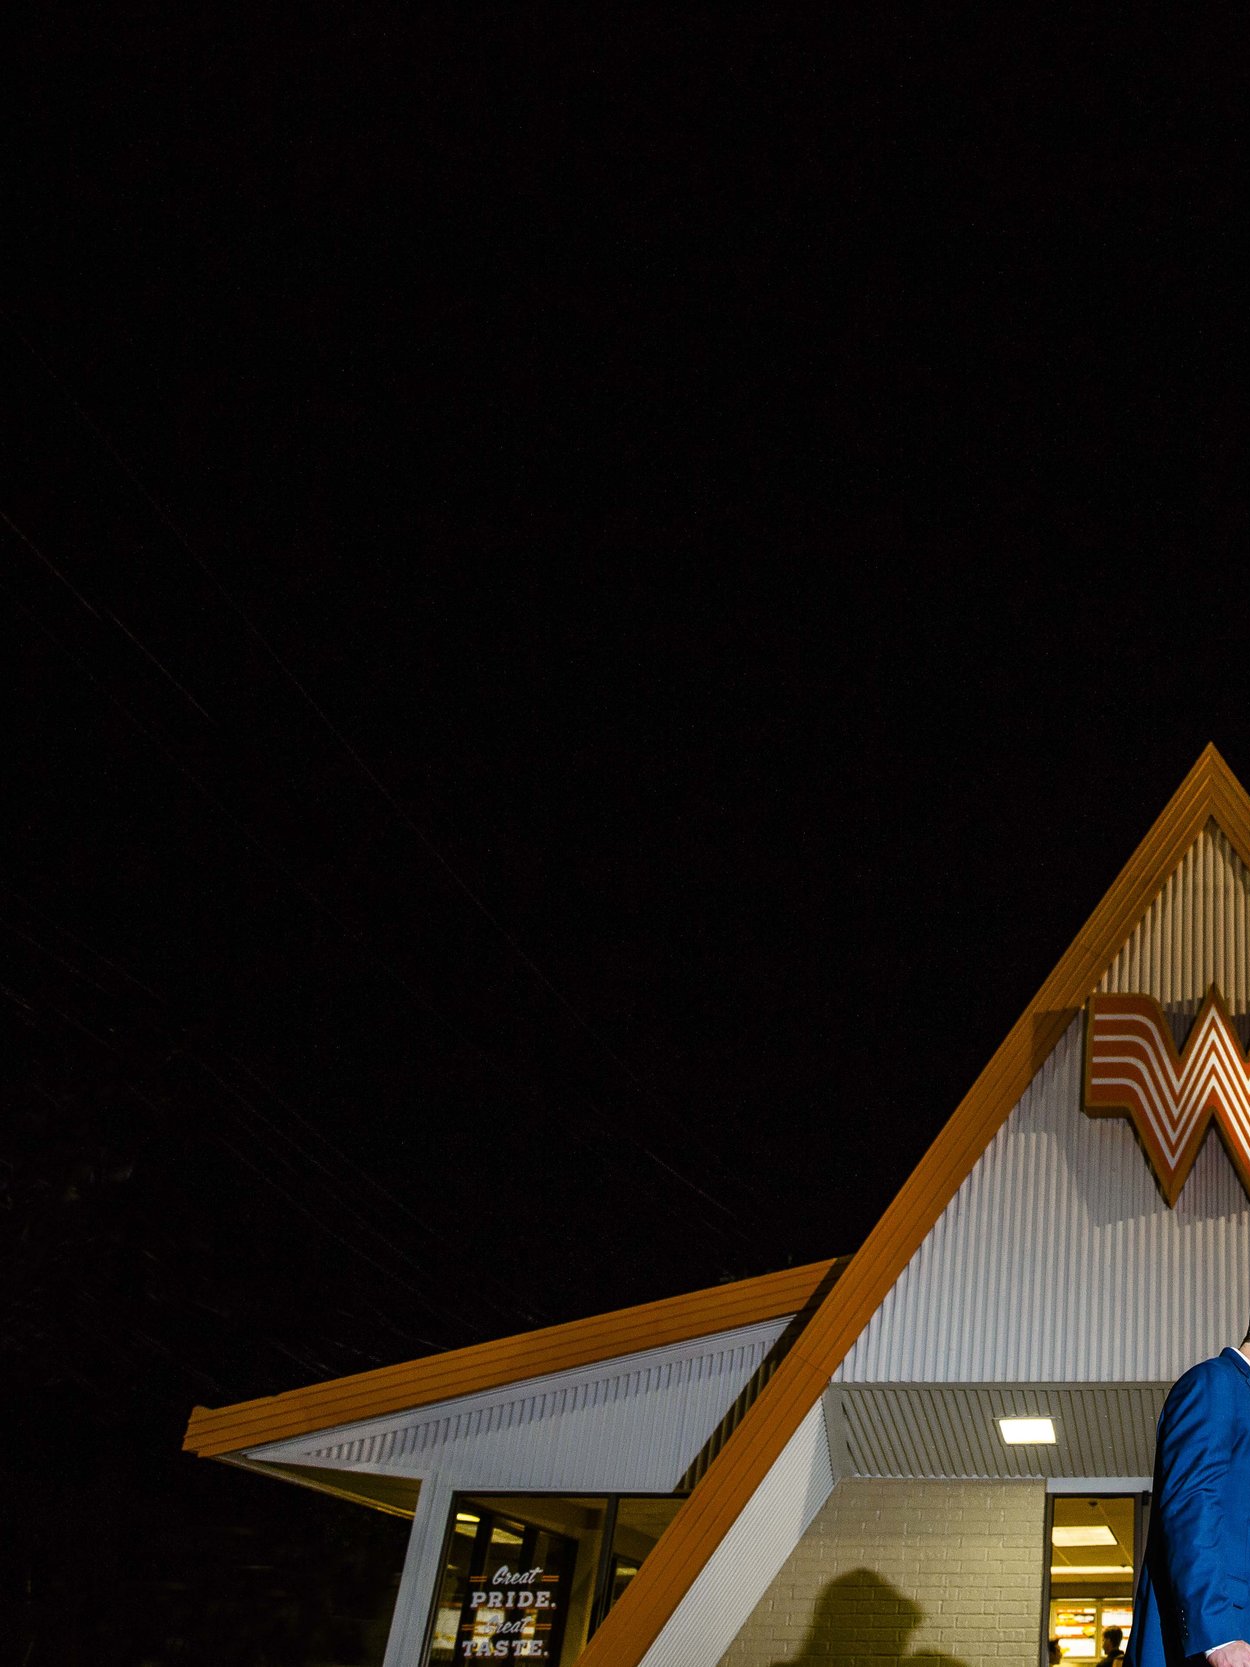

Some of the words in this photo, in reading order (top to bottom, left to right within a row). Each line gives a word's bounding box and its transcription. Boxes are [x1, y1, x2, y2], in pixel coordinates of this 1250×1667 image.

[492, 1565, 544, 1585] Great
[470, 1591, 557, 1608] PRIDE.
[484, 1616, 534, 1634] Great
[462, 1640, 549, 1657] TASTE.
